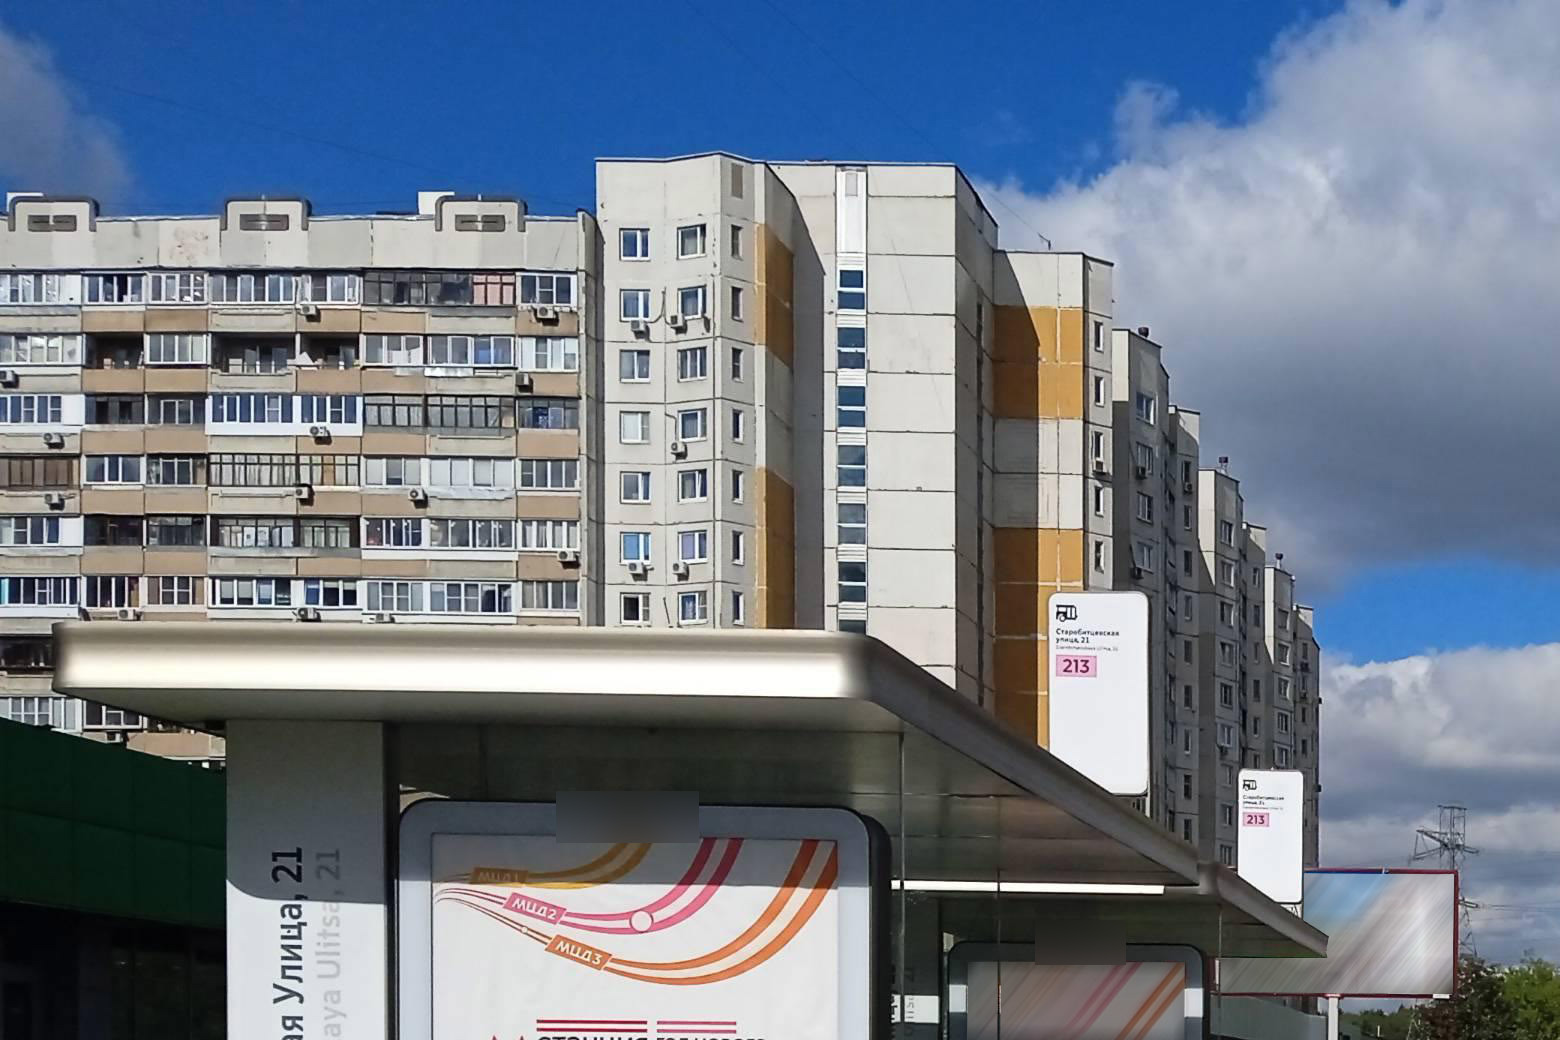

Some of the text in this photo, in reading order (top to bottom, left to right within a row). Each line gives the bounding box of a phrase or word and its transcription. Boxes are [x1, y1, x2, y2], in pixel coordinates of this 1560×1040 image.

[1062, 658, 1090, 674] 213
[1246, 814, 1265, 825] 213
[271, 846, 303, 884] 21
[314, 848, 341, 881] 21
[272, 894, 309, 1005] Улица,
[315, 889, 345, 979] Ulitsa,
